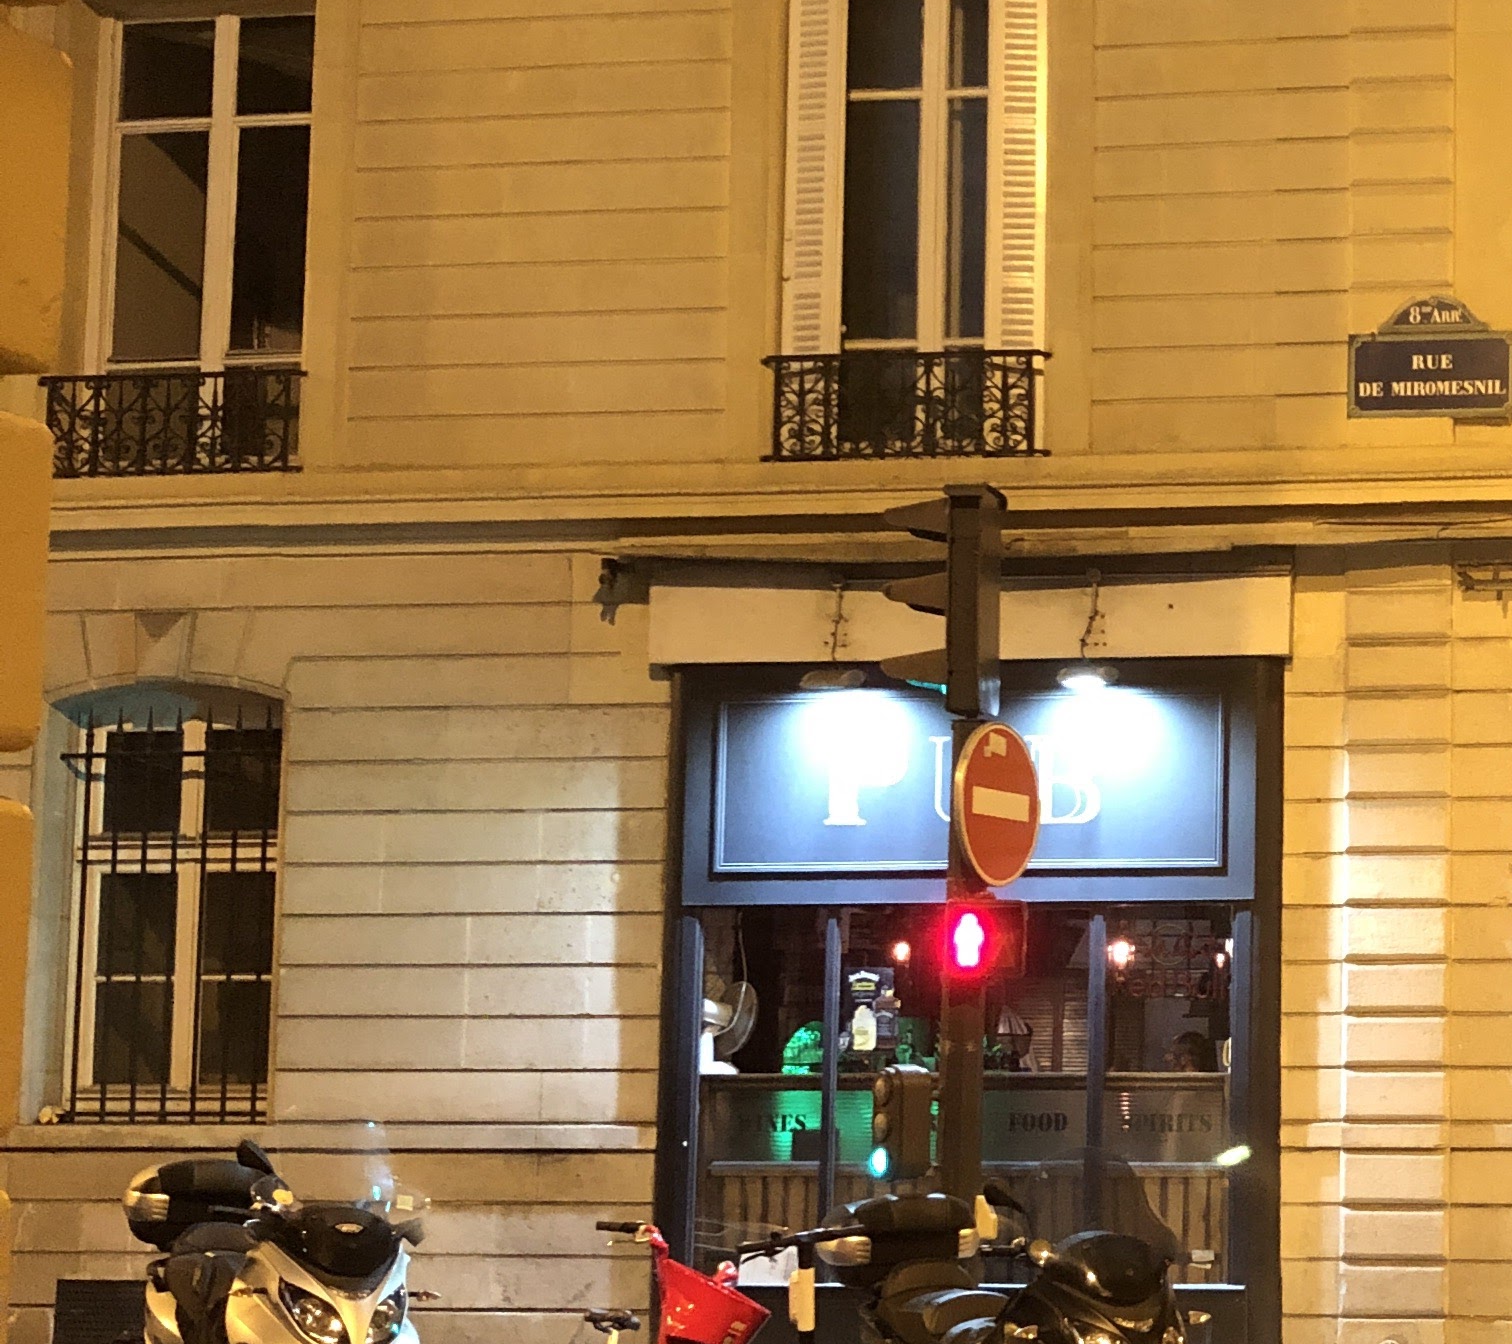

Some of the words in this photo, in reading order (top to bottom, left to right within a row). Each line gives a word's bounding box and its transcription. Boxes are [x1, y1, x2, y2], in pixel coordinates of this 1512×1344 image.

[1412, 354, 1453, 370] RUE
[1358, 381, 1383, 397] DE
[1391, 379, 1507, 397] MIROMESNIL
[1008, 1112, 1068, 1133] FOOD
